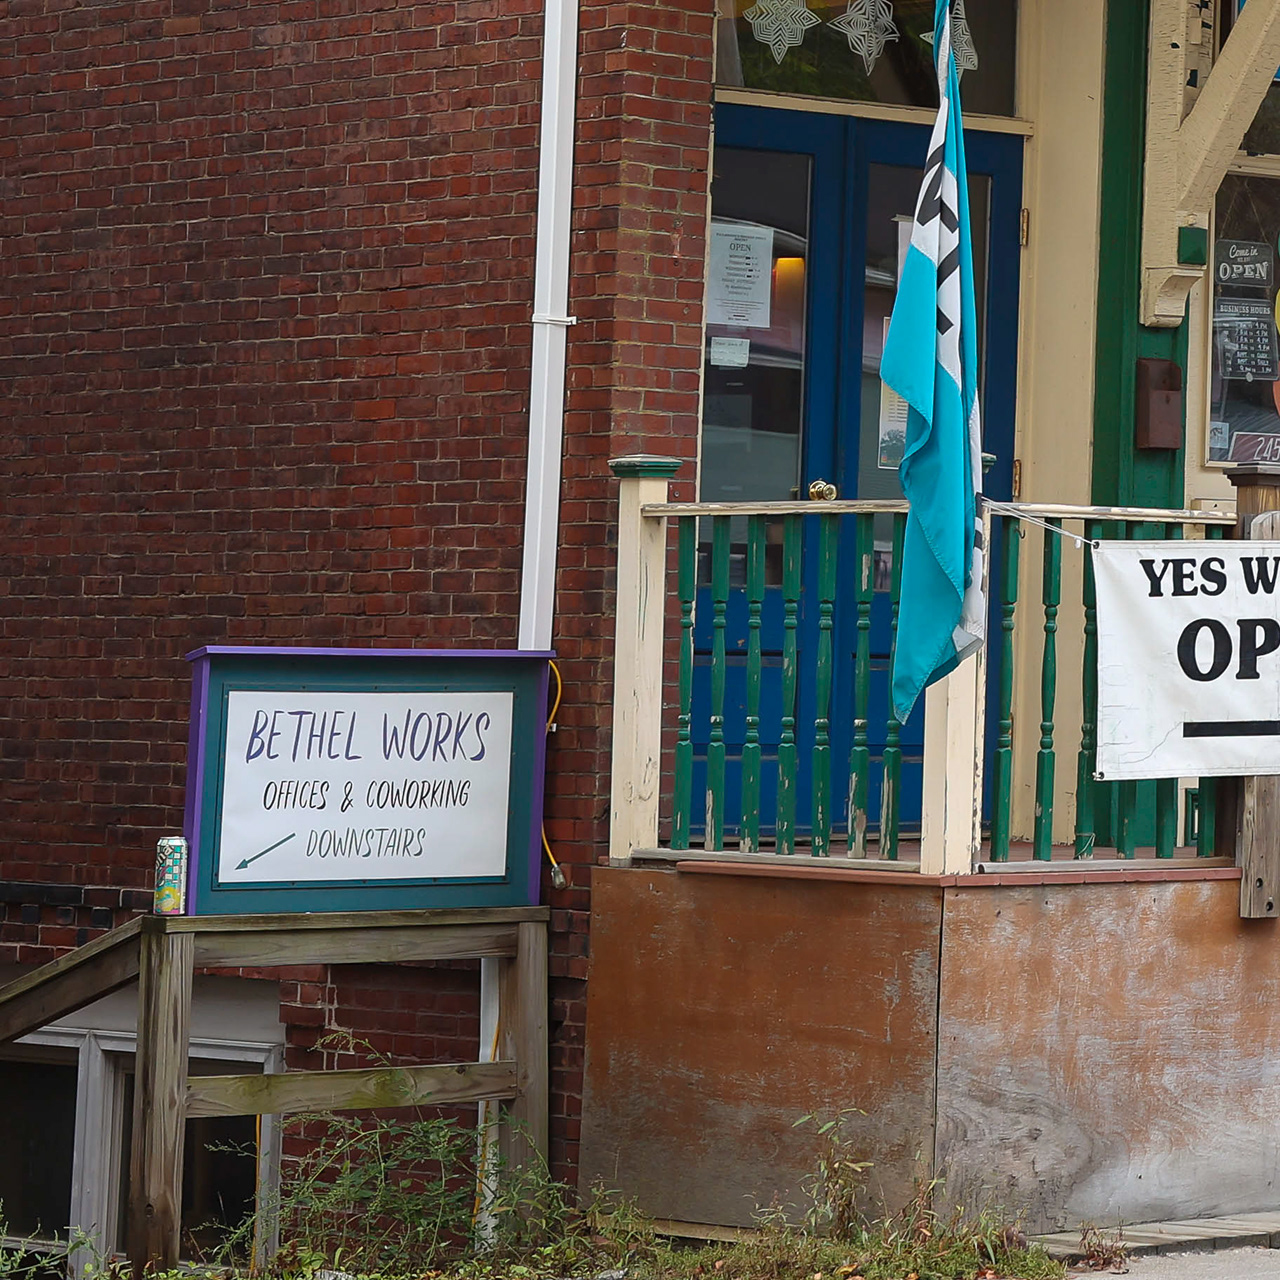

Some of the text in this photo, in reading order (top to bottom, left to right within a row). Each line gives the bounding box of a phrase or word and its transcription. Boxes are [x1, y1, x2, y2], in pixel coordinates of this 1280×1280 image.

[729, 242, 752, 252] OPEN
[1229, 244, 1259, 259] Come in
[1219, 261, 1269, 281] OPEN
[1220, 304, 1271, 315] BUSINESS HOURS
[1139, 557, 1228, 597] YES
[246, 708, 491, 764] BETHEL WORKS
[263, 779, 472, 813] OFFICES & COWORKING
[305, 827, 427, 858] DOWNSTAIRS
